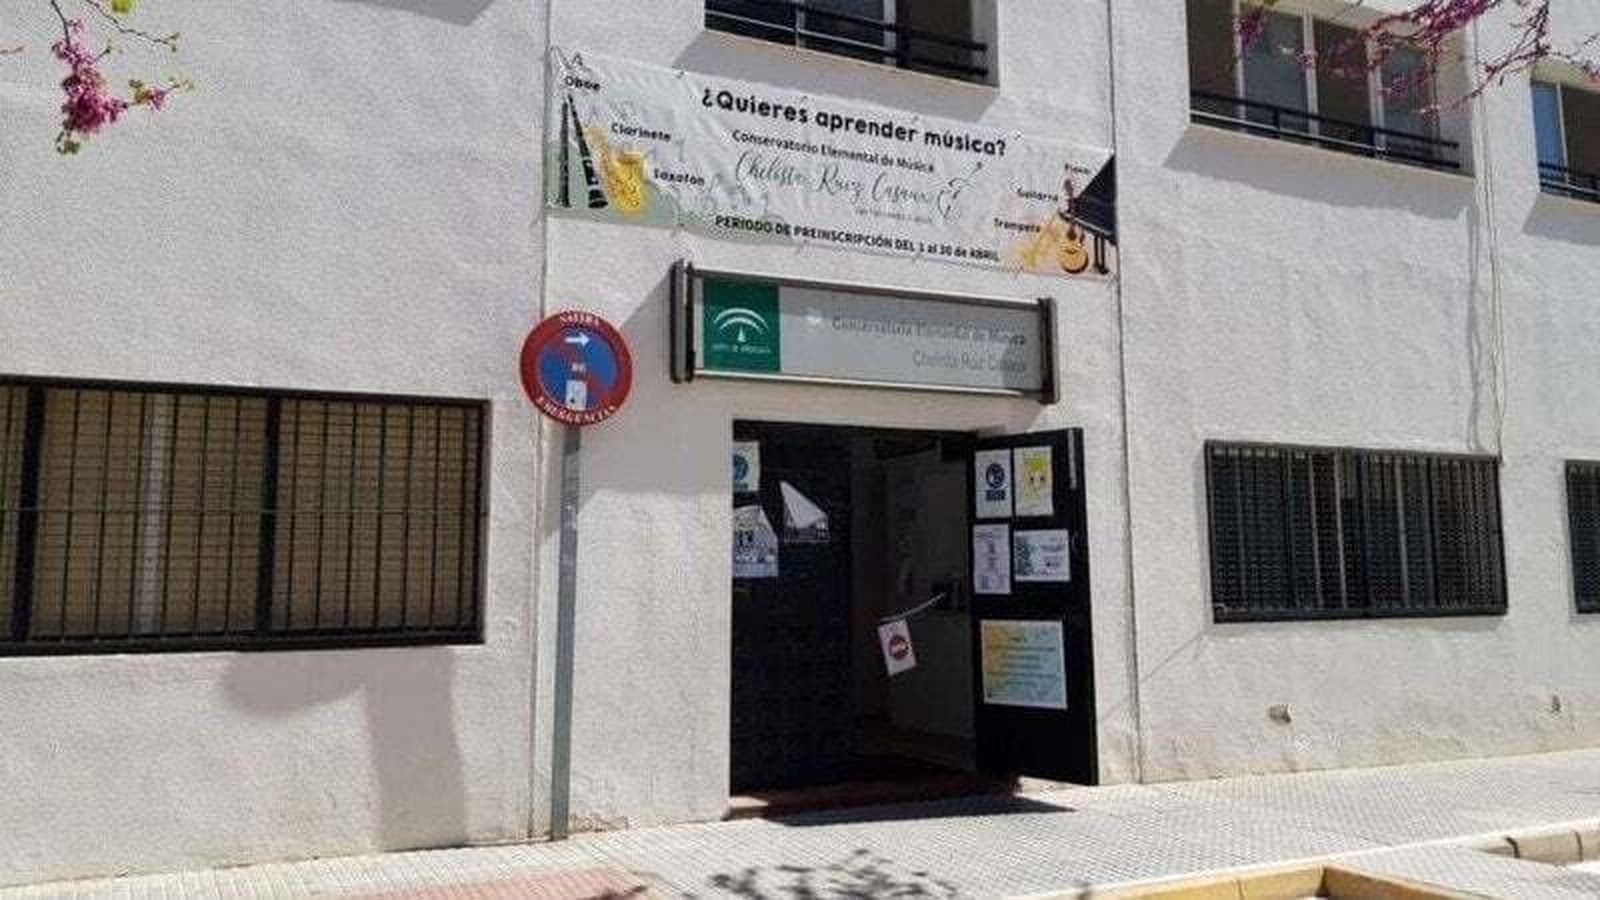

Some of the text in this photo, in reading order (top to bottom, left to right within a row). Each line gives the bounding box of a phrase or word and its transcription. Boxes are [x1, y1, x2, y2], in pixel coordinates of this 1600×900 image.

[564, 75, 602, 92] Oboe
[611, 122, 672, 142] Clarinete
[701, 88, 1007, 156] ¿Quieres aprender música?
[732, 129, 819, 154] Conservatorio
[881, 155, 894, 167] de
[775, 222, 792, 236] DE
[895, 238, 915, 252] DEL
